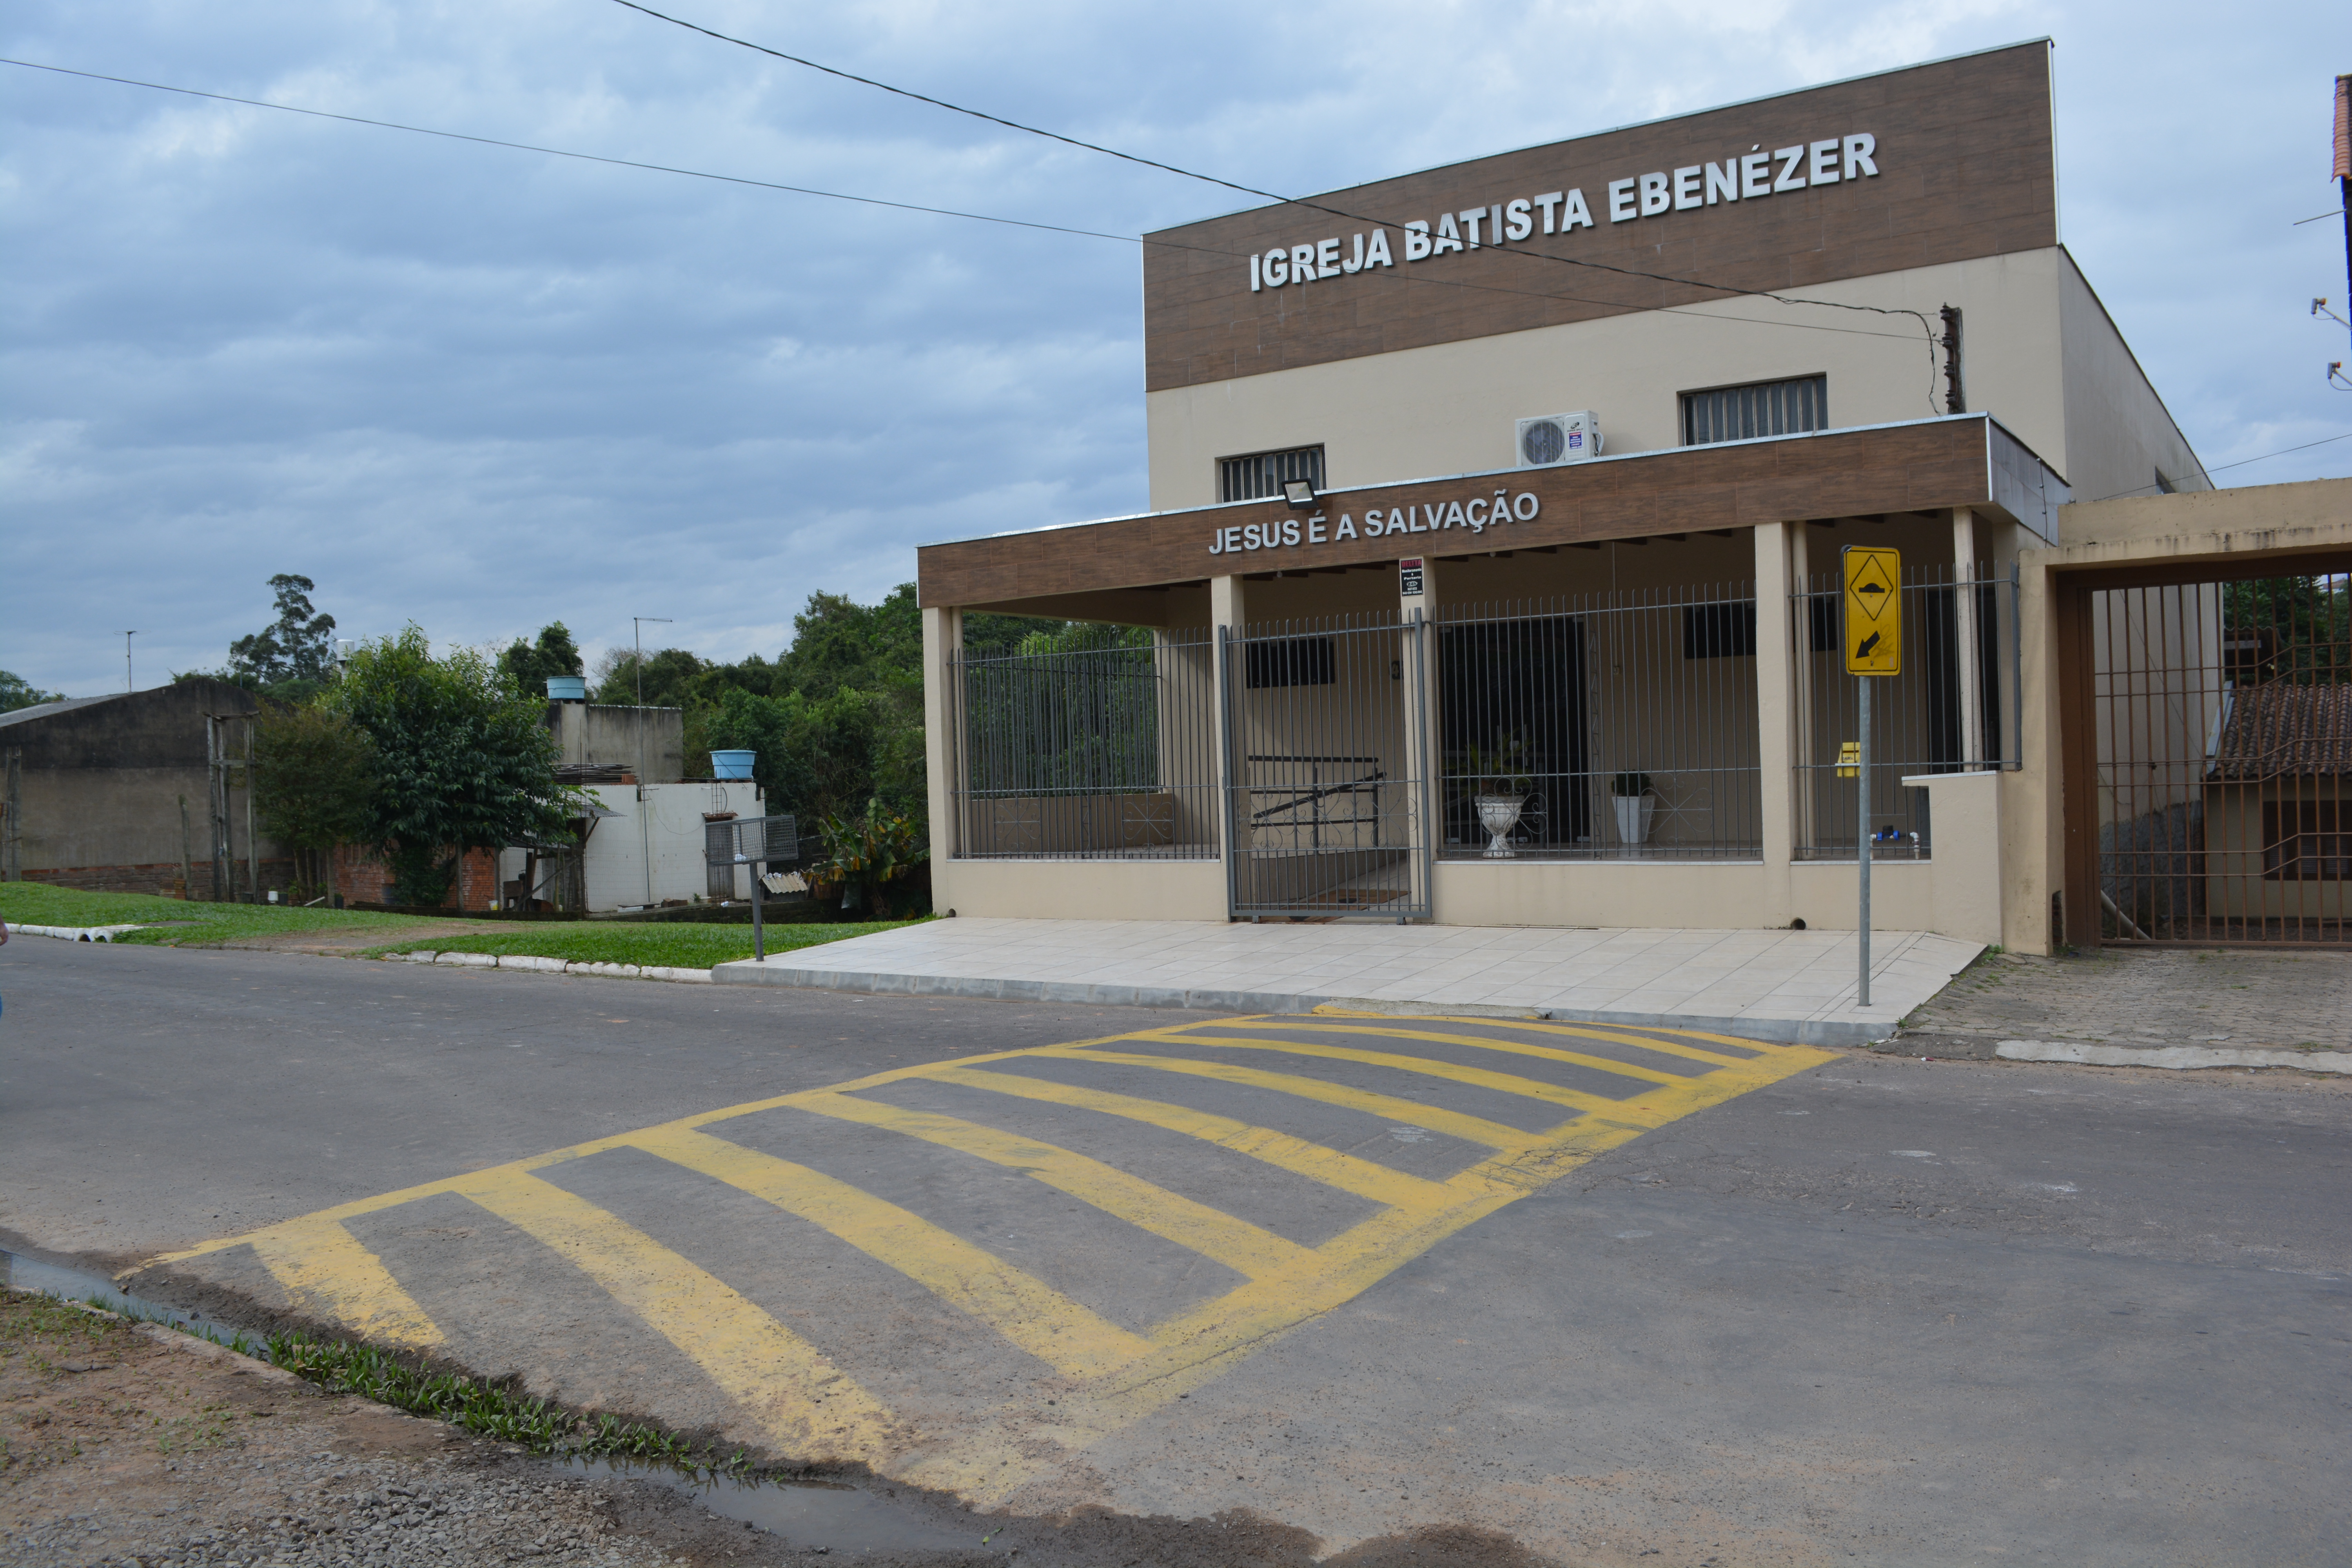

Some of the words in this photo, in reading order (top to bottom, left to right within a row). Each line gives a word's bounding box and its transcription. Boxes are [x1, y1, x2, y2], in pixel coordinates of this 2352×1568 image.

[1250, 229, 1393, 291] IGREJA
[1405, 188, 1595, 261] BATISTA
[1609, 133, 1879, 223] EBENÉZER
[1209, 520, 1301, 554] JESUS
[1309, 510, 1327, 543] É
[1336, 514, 1358, 540] A
[1365, 489, 1539, 536] SALVAÇÃO
